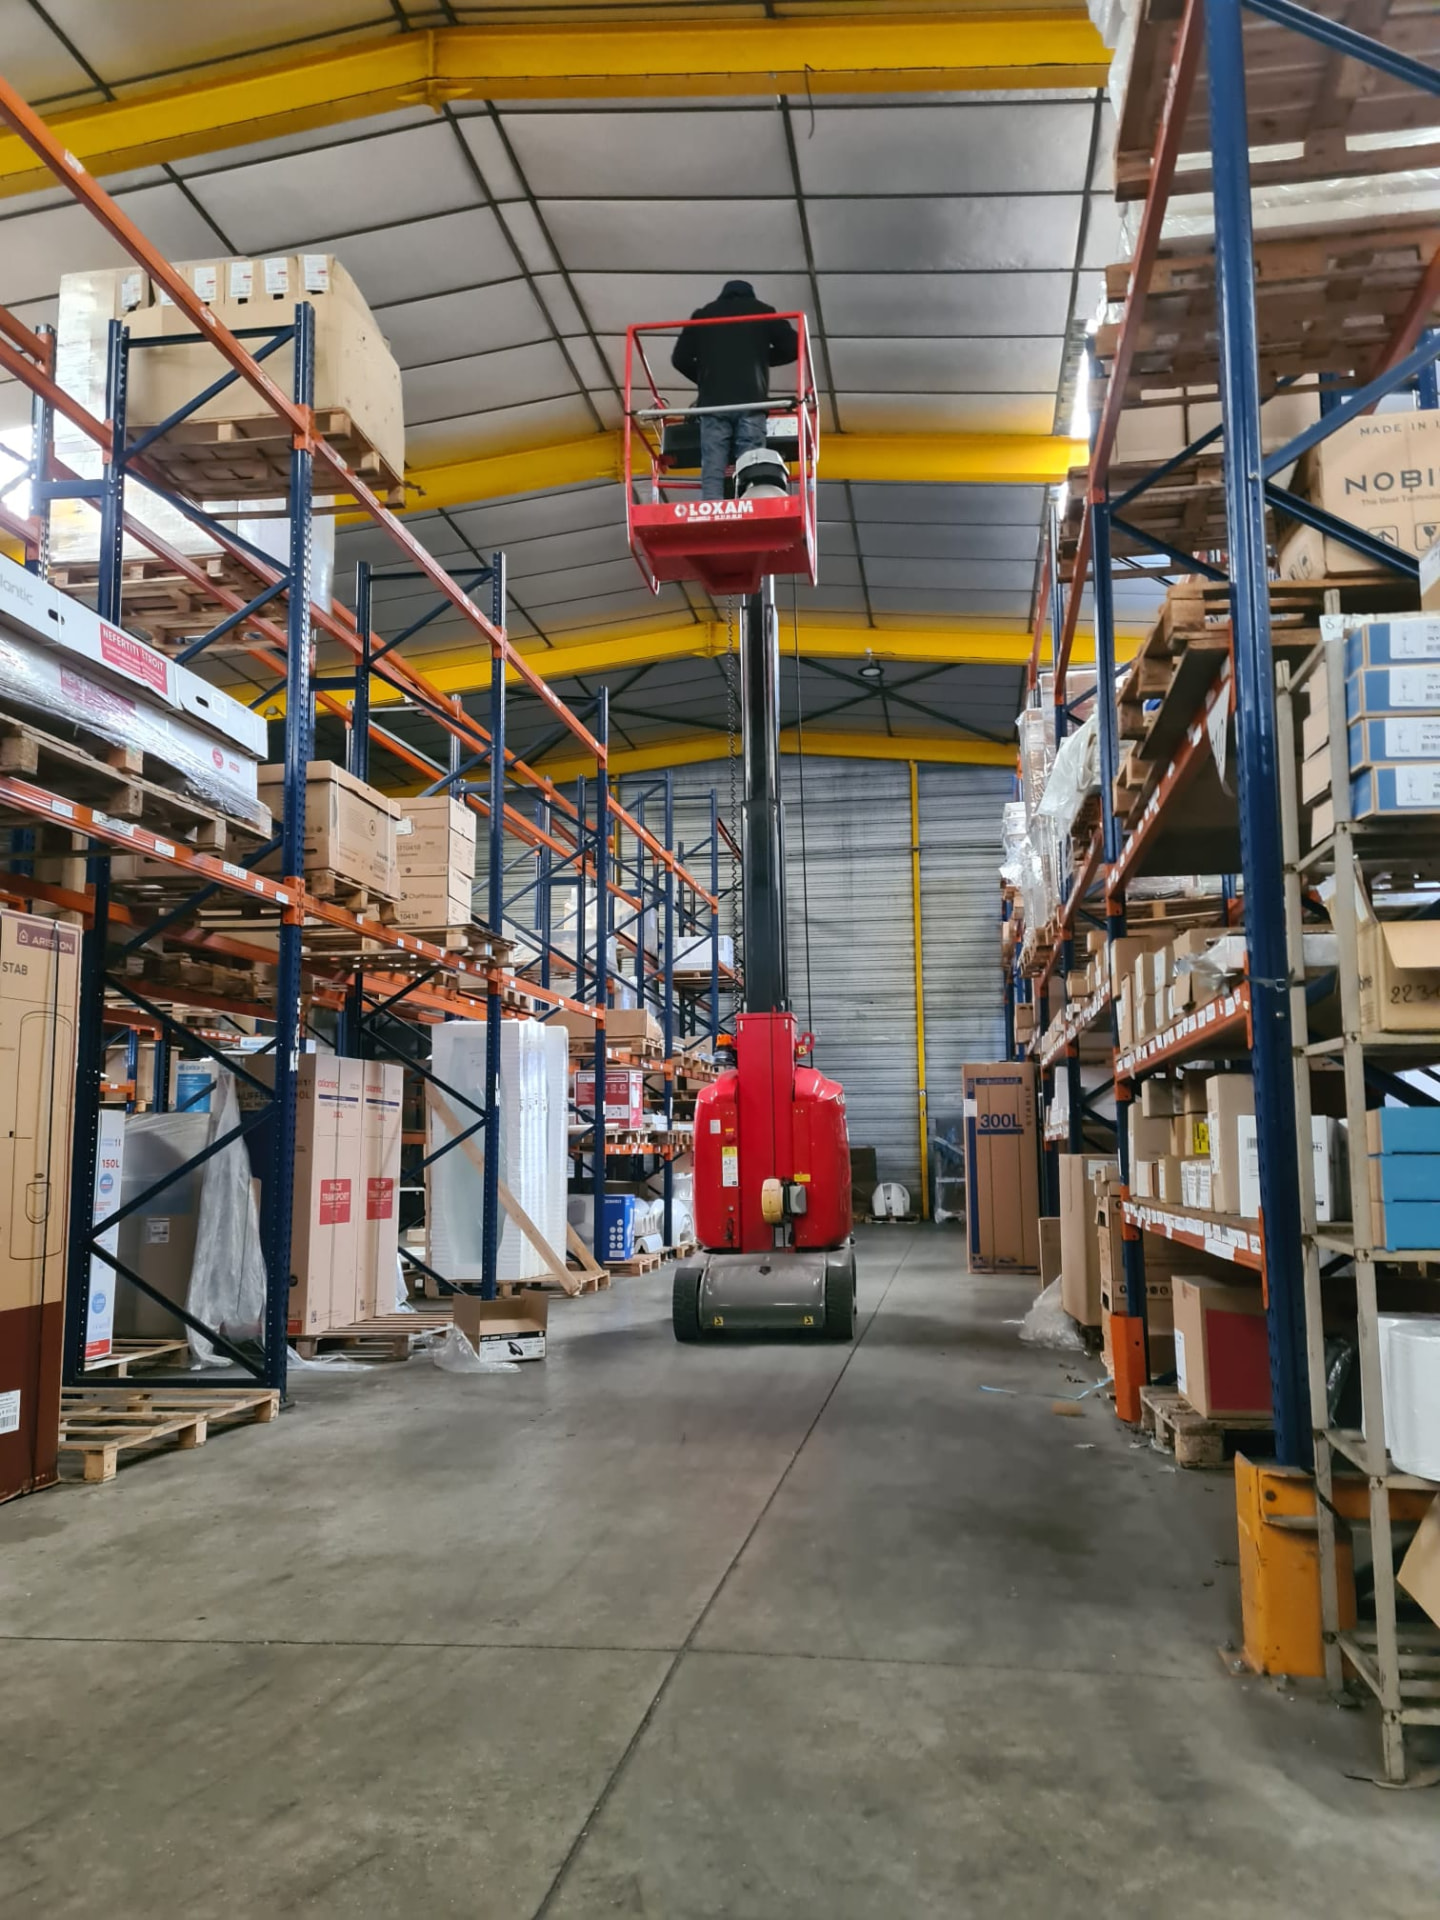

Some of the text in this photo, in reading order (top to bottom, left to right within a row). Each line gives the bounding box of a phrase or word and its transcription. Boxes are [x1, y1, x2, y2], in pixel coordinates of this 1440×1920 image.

[1360, 423, 1402, 437] MADE
[1411, 421, 1426, 431] IN
[1344, 467, 1440, 496] NOBI
[688, 500, 754, 516] LOXAM
[1380, 496, 1399, 504] Best
[102, 626, 141, 657] NEFERTITI
[31, 936, 73, 952] ARISON
[2, 961, 28, 976] STAB
[980, 1113, 1023, 1129] 300L
[102, 1159, 120, 1168] 150L
